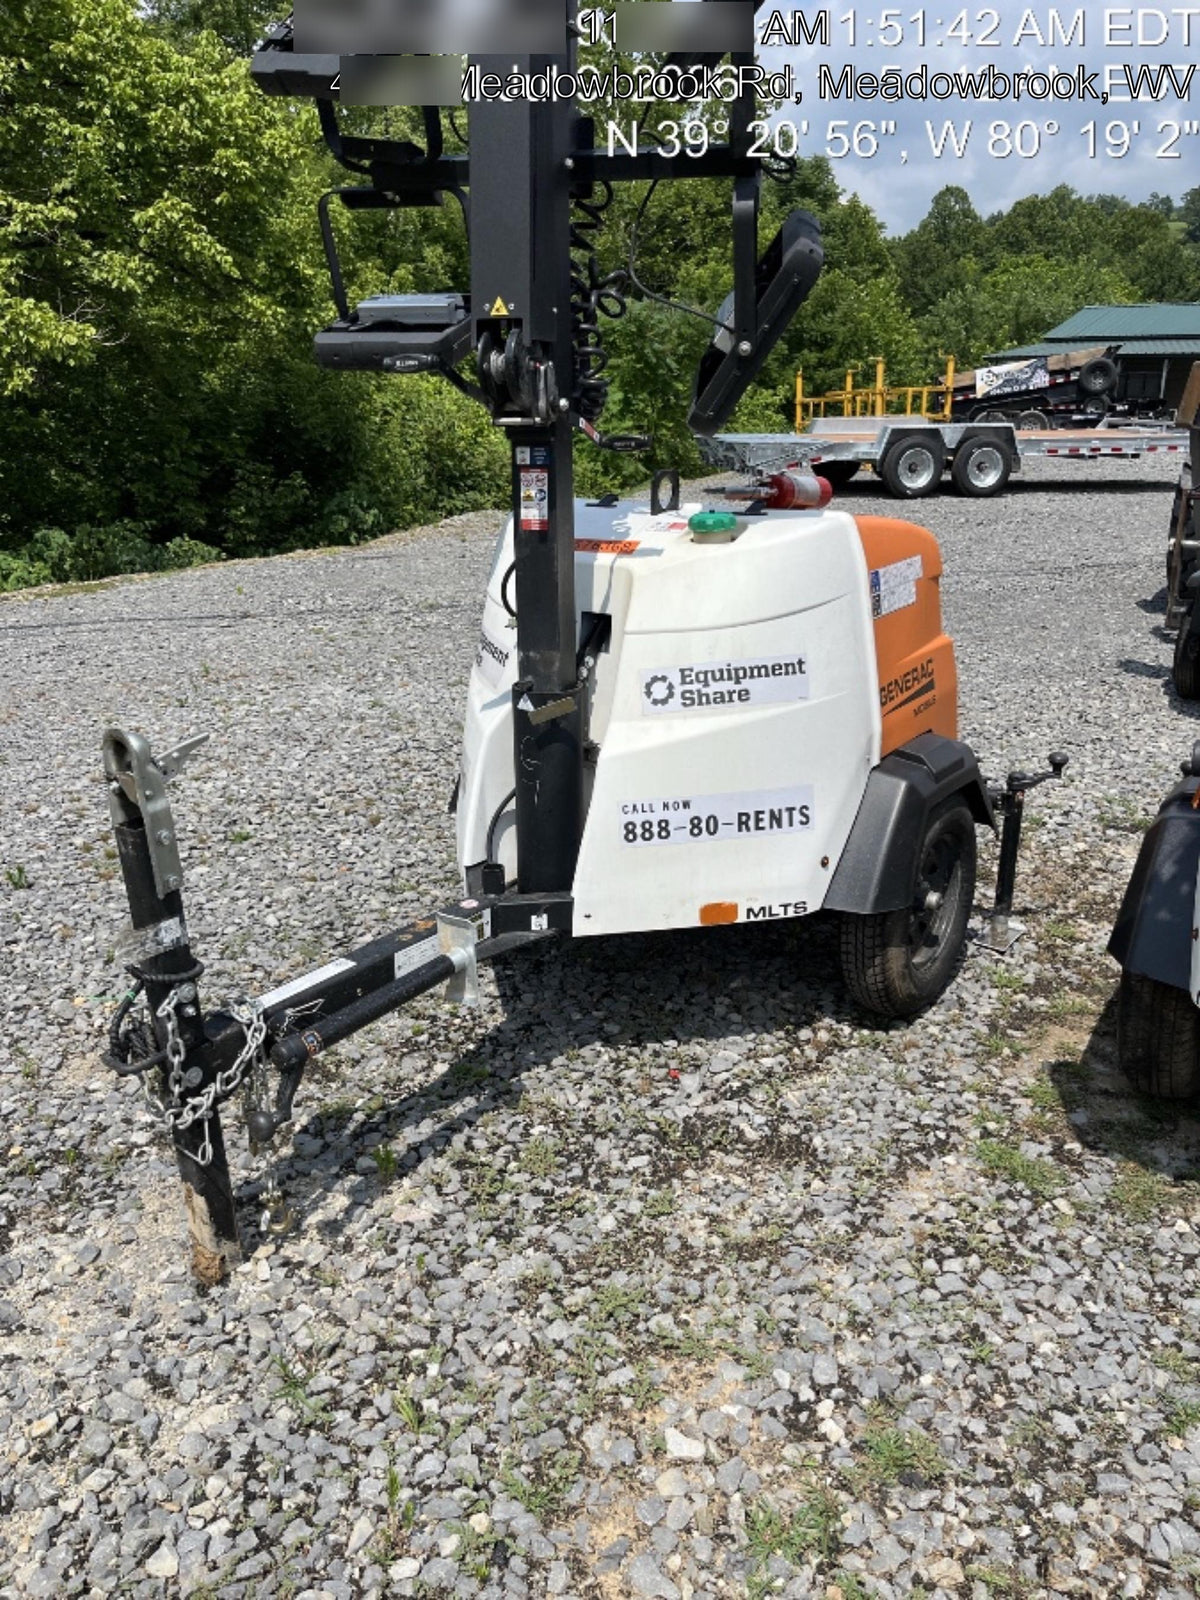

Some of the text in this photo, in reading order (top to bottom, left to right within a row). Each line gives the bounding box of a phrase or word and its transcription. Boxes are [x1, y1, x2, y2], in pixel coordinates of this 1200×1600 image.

[679, 658, 806, 688] Equipment
[880, 658, 934, 707] GENERAC
[680, 688, 751, 708] Share
[622, 800, 691, 814] CALL NOW
[623, 805, 811, 843] 888-80-RENTS
